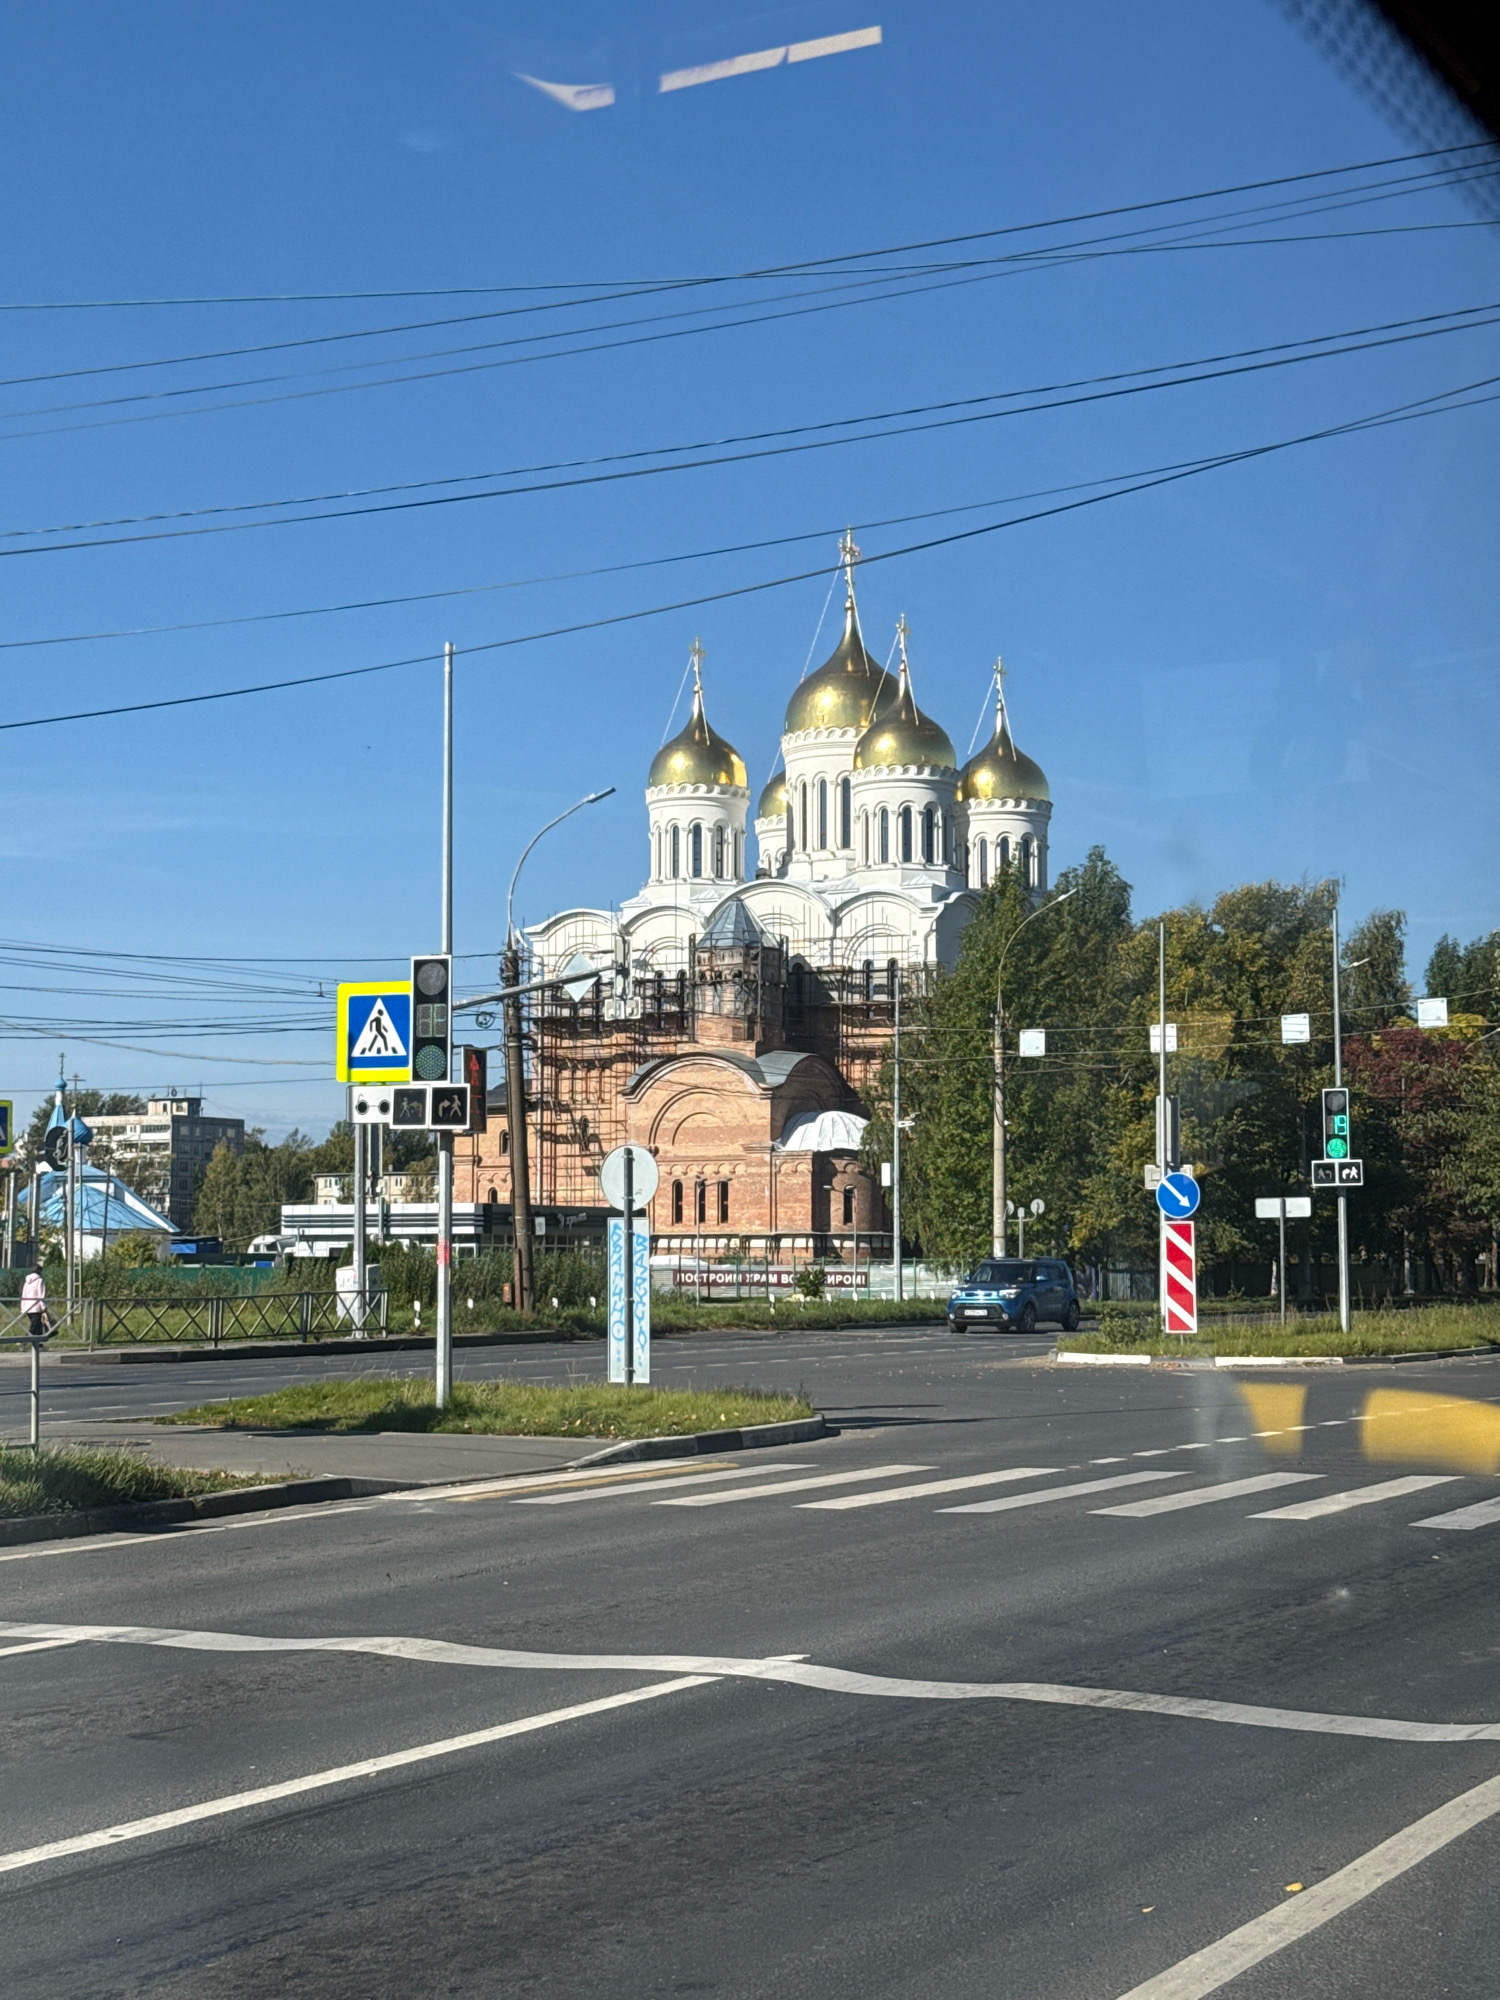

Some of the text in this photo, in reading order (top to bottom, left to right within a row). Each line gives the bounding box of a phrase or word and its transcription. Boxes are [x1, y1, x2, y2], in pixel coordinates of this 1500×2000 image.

[1334, 1114, 1347, 1130] 19
[677, 1272, 742, 1283] ПОСТРОИМ
[746, 1273, 778, 1284] ХРАМ
[825, 1274, 866, 1285] ИРОМ!
